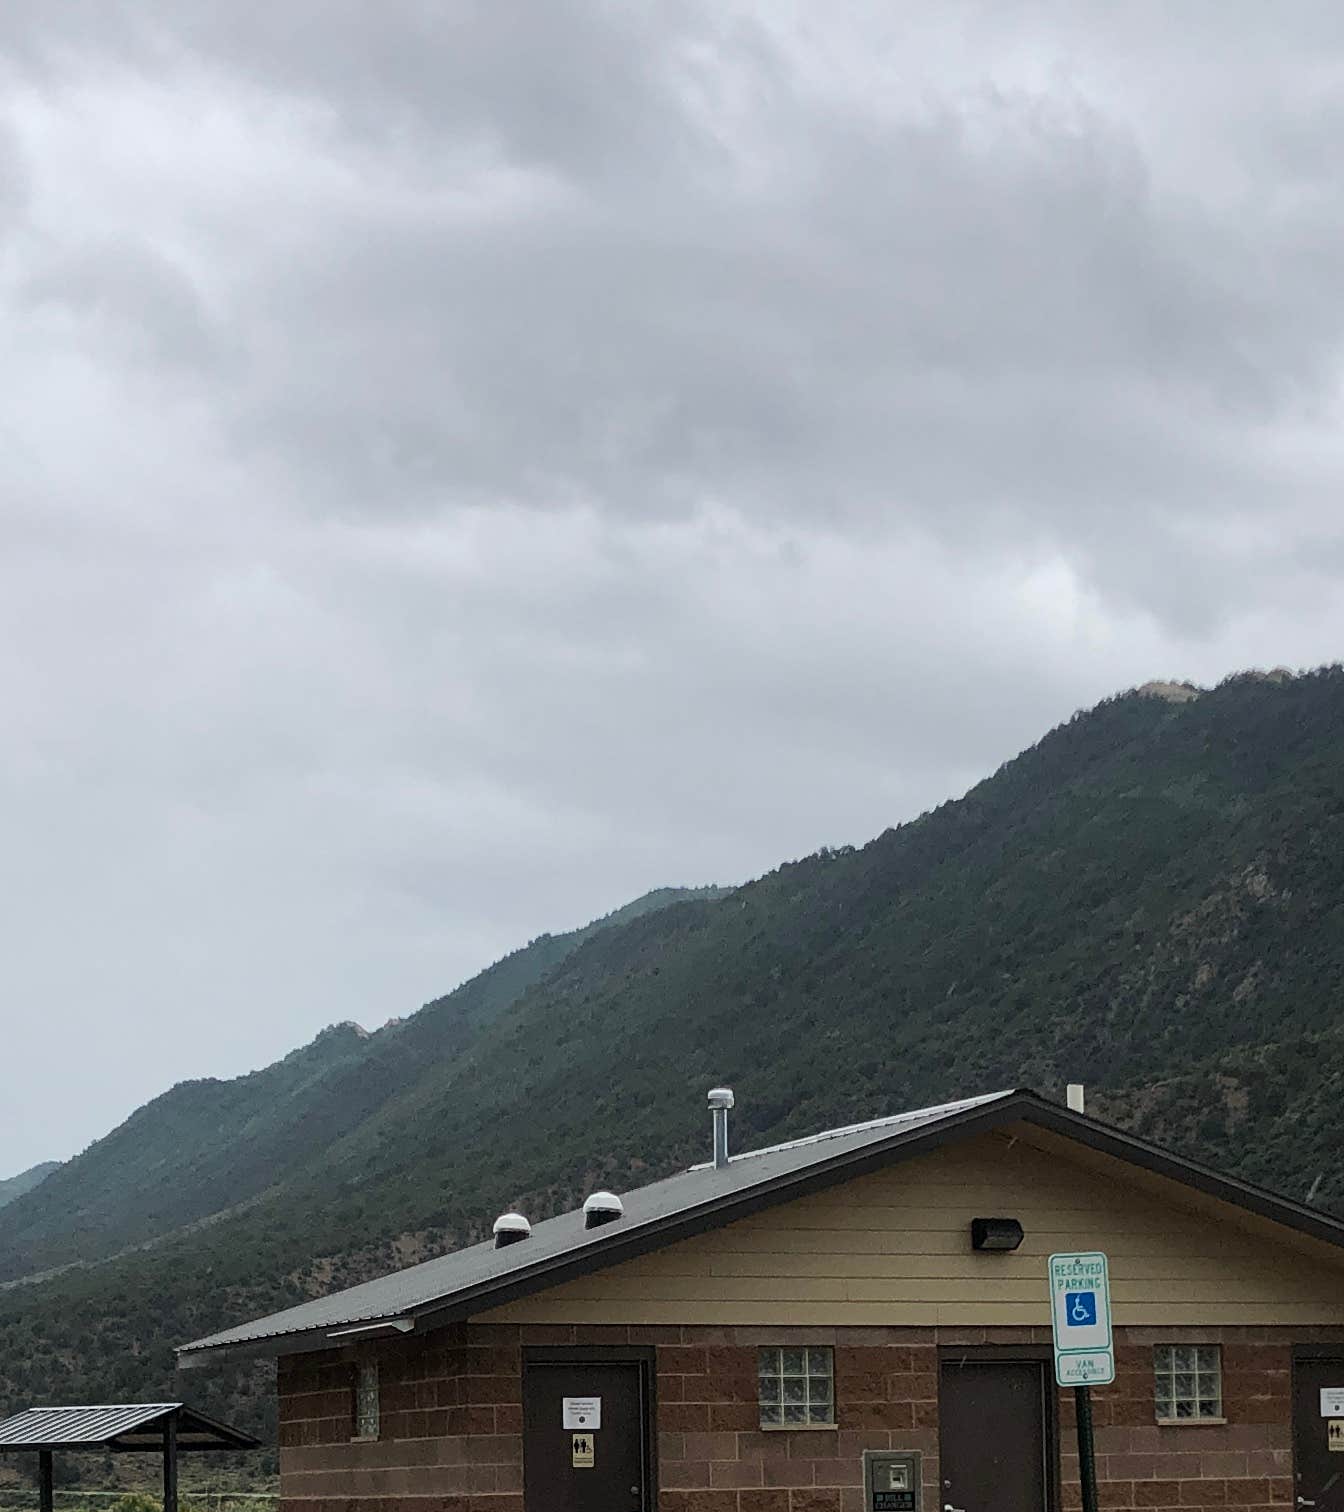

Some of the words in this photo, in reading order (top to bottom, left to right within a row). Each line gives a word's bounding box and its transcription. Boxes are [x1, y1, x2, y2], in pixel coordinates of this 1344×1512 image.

[1054, 1262, 1103, 1277] RESERVED
[1057, 1278, 1101, 1290] PARKING
[1075, 1359, 1094, 1369] VAN
